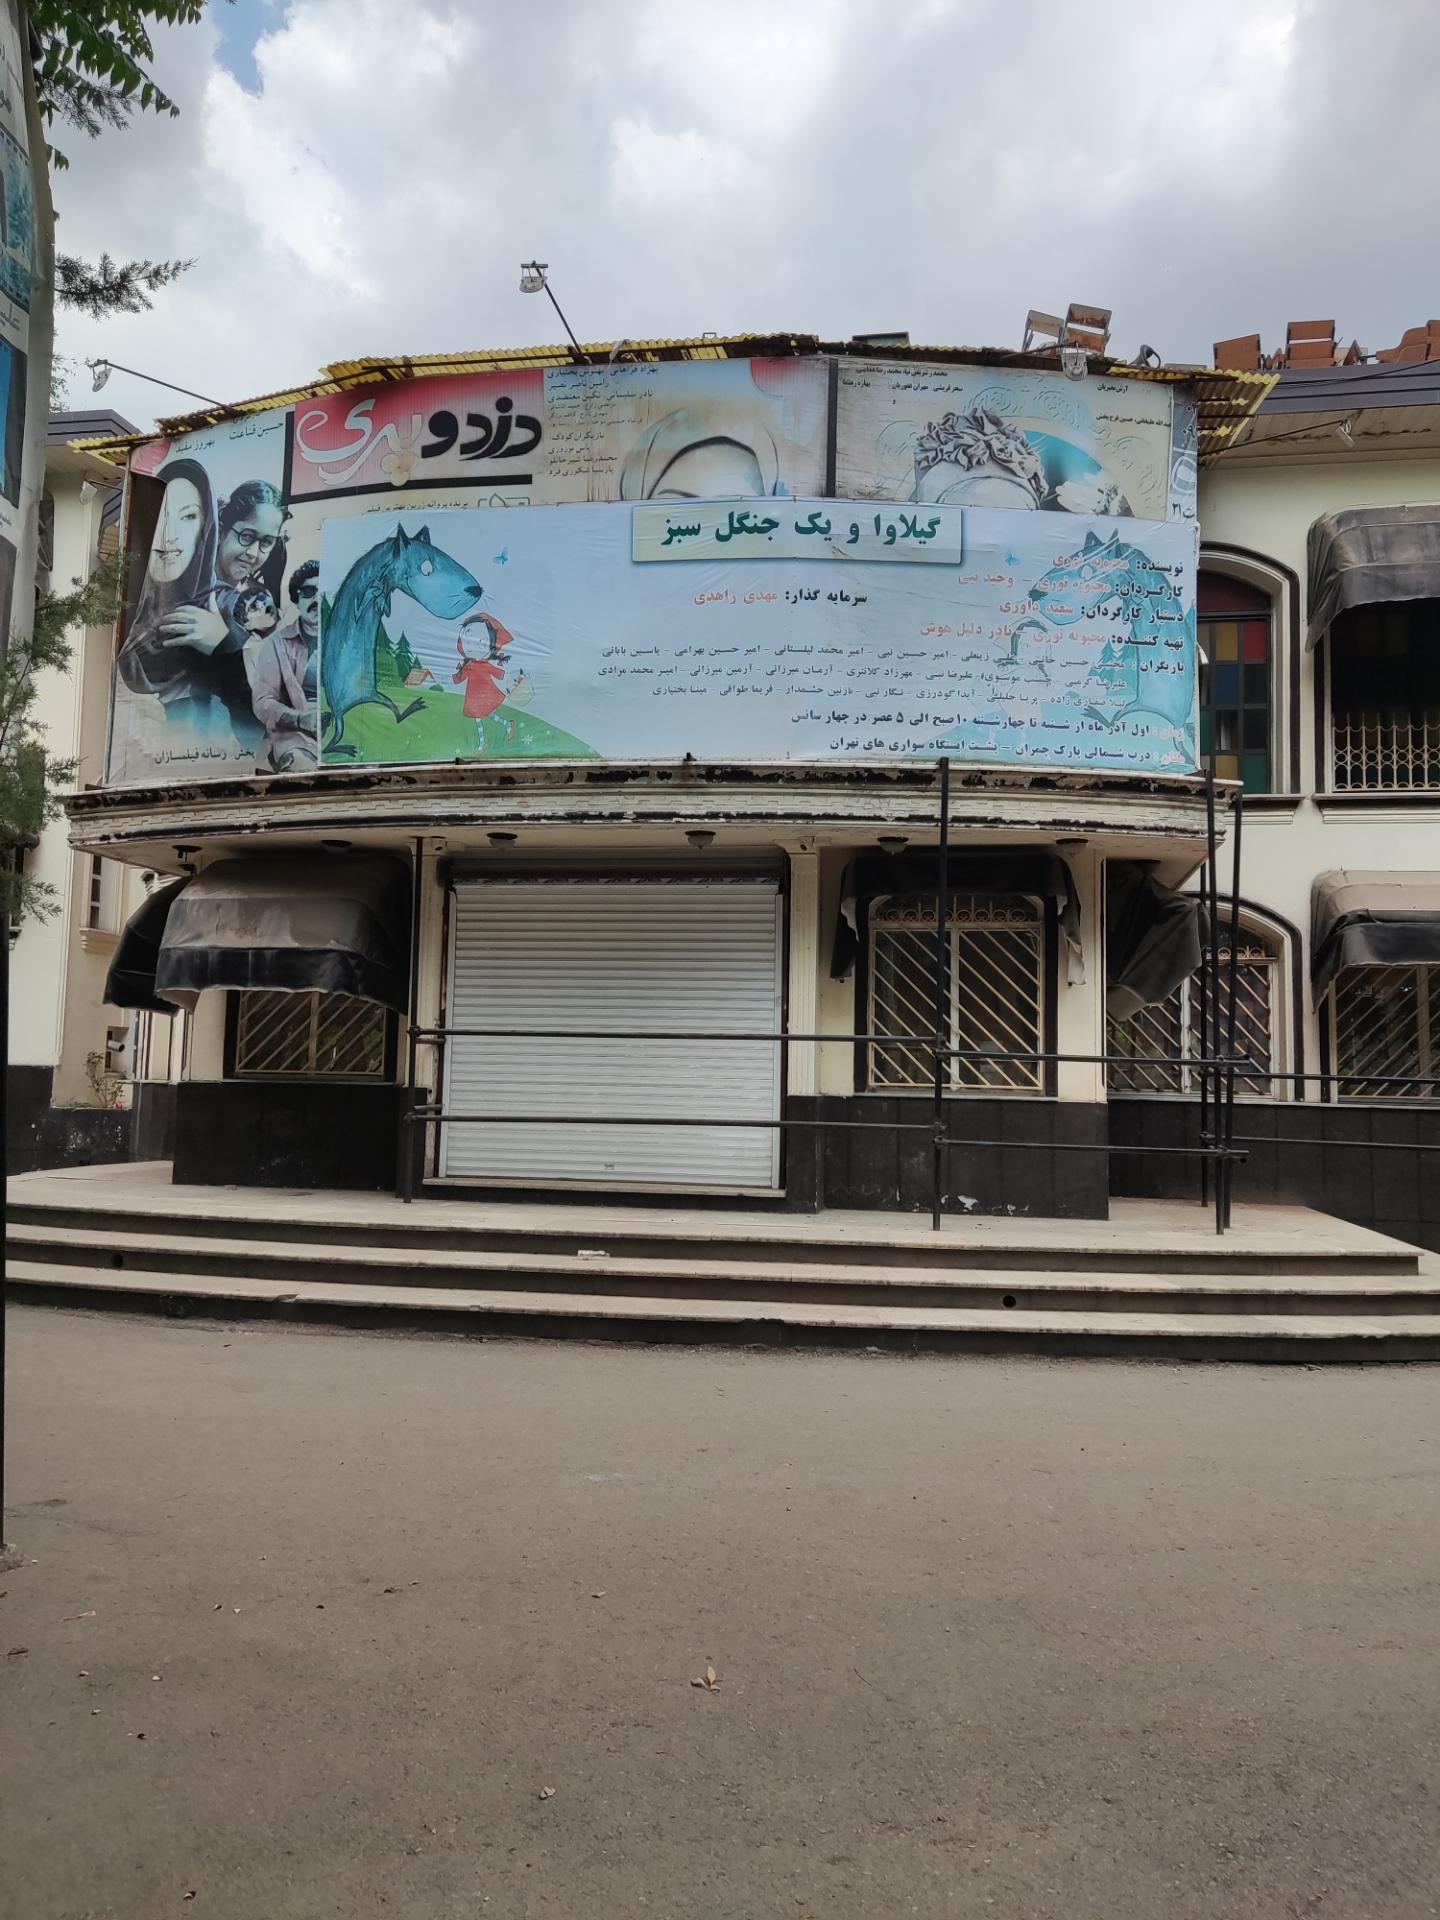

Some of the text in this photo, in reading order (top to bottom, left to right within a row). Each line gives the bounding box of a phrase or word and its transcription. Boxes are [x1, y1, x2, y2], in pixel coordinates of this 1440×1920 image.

[229, 422, 284, 440] حسین قناعت
[194, 439, 216, 451] بهروز
[660, 518, 701, 546] سبز
[714, 510, 780, 542] جنگل
[794, 511, 832, 542] یک
[846, 520, 860, 544] و
[694, 589, 736, 606] زاهدی
[743, 590, 779, 605] مهدی
[826, 589, 868, 606] سرمایه
[1149, 607, 1184, 624] دستیار
[920, 624, 952, 638] هوش
[956, 622, 982, 638] دلیل
[988, 624, 1012, 640] نادر
[1164, 634, 1184, 650] تهیه
[630, 646, 660, 657] یاسین
[674, 646, 706, 657] بهرامی
[708, 647, 740, 656] حسین
[744, 645, 760, 656] امیر
[847, 647, 864, 657] امیر
[877, 648, 894, 659] نبی
[896, 650, 928, 659] حسین
[932, 650, 948, 661] امیر
[802, 664, 832, 675] آرمان
[1060, 659, 1089, 668] حسین
[598, 666, 627, 677] مرادی
[658, 666, 678, 677] امیر
[726, 664, 752, 676] آرمین
[846, 666, 881, 678] کلانتری
[884, 668, 912, 680] مهرزاد
[947, 670, 974, 681] علیرضا
[652, 684, 687, 696] بختیاری
[690, 684, 707, 694] مینا
[752, 684, 773, 696] فریما
[865, 690, 880, 698] نبی
[883, 688, 904, 698] نگار
[791, 710, 822, 723] سانس
[853, 712, 867, 725] در
[872, 713, 894, 725] عصر
[896, 712, 904, 724] ۵
[909, 712, 929, 726] الی
[1029, 718, 1037, 728] تا
[1041, 720, 1070, 730] شنبه
[1074, 720, 1084, 733] از
[1088, 720, 1104, 732] ماه
[1108, 721, 1127, 735] آذر
[1131, 724, 1150, 736] اول
[830, 736, 860, 750] تهران
[862, 737, 885, 750] های
[888, 738, 925, 752] سواری
[929, 739, 965, 752] ایستگاه
[154, 746, 256, 764] پخش رسانه فیلمسازان
[1084, 748, 1124, 760] شمالی
[1128, 751, 1151, 762] درب
